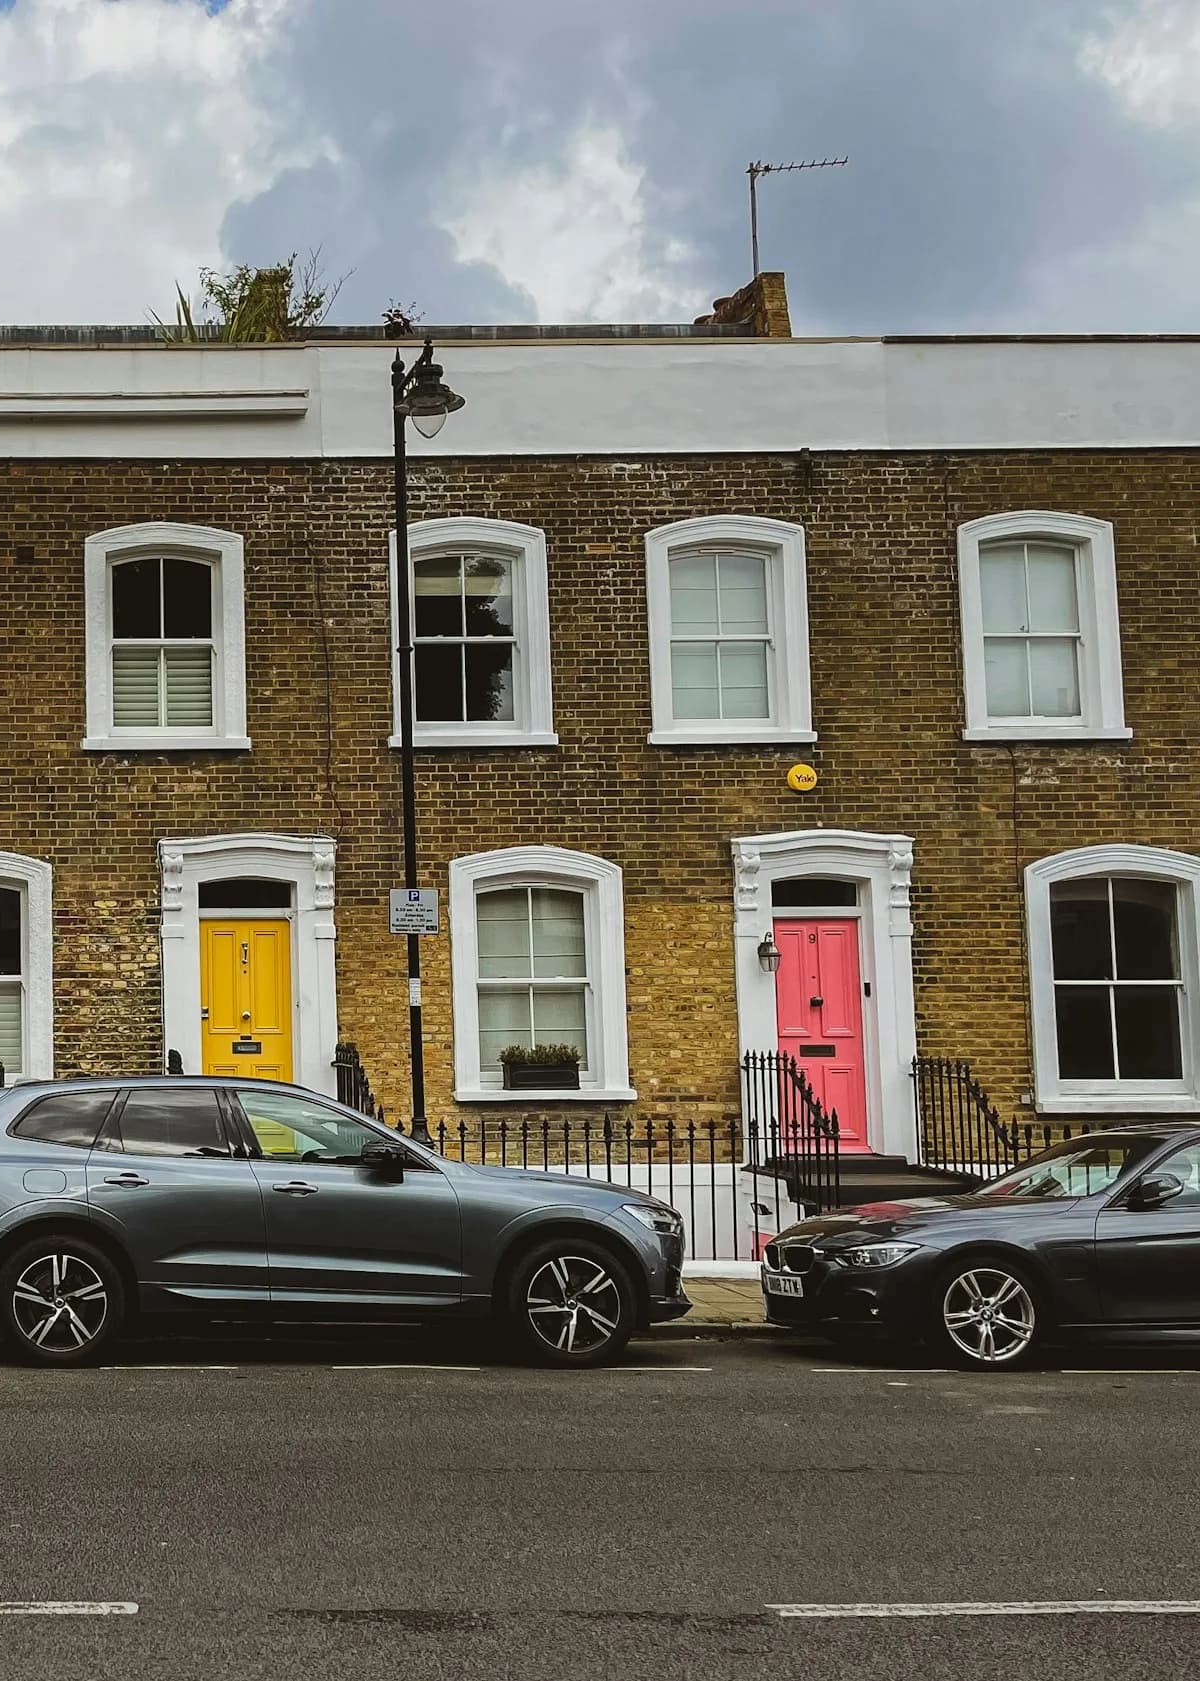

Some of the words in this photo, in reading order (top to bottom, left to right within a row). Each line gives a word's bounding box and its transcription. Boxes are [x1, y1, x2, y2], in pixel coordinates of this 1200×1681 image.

[795, 774, 814, 783] Yale
[410, 891, 419, 900] P
[808, 933, 816, 944] 9
